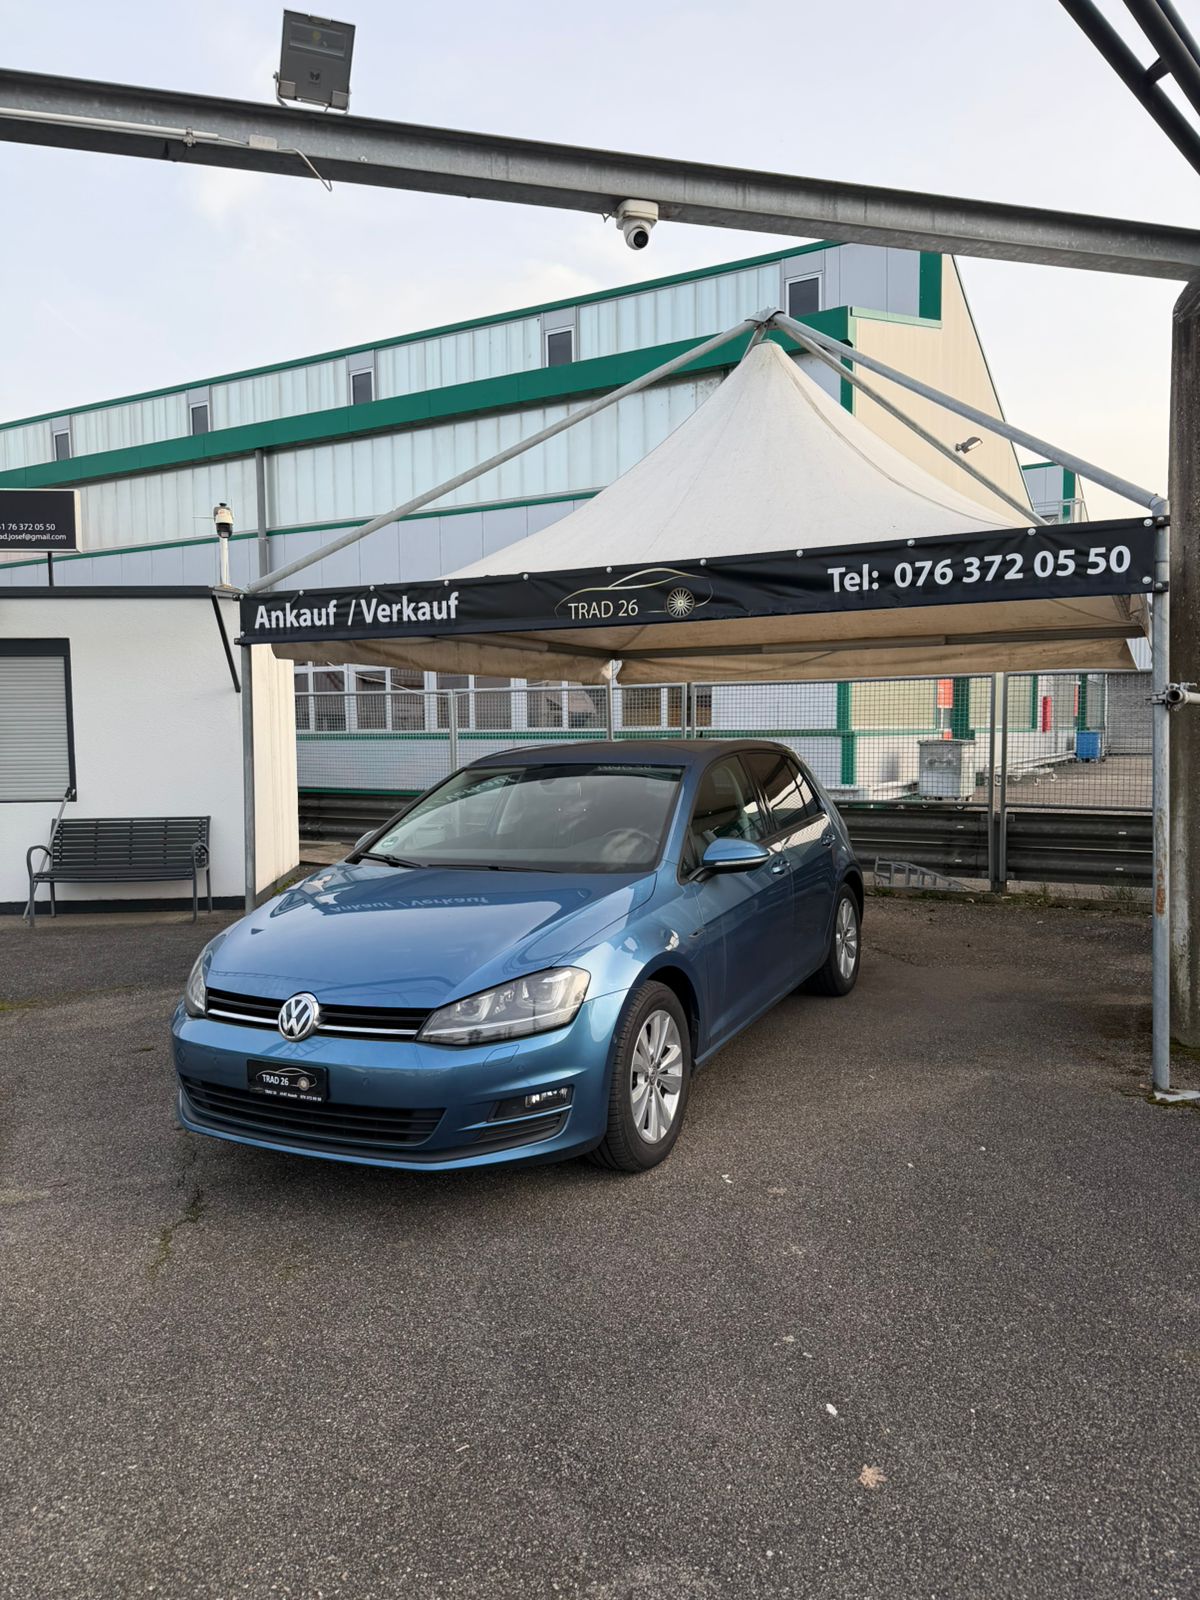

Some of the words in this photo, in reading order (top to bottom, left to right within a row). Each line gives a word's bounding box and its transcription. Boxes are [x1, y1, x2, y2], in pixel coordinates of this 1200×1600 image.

[7, 523, 18, 531] 76
[19, 523, 33, 531] 372
[34, 523, 44, 531] 05
[46, 523, 56, 531] 50
[827, 563, 879, 593] Tel:
[894, 558, 954, 588] 076
[962, 552, 1024, 583] 372
[1033, 549, 1076, 578] 05
[1086, 545, 1131, 575] 50
[254, 599, 338, 629] Ankauf
[567, 600, 614, 620] TRAD
[618, 599, 639, 617] 26
[262, 1074, 280, 1085] TRAD
[280, 1077, 289, 1086] 26
